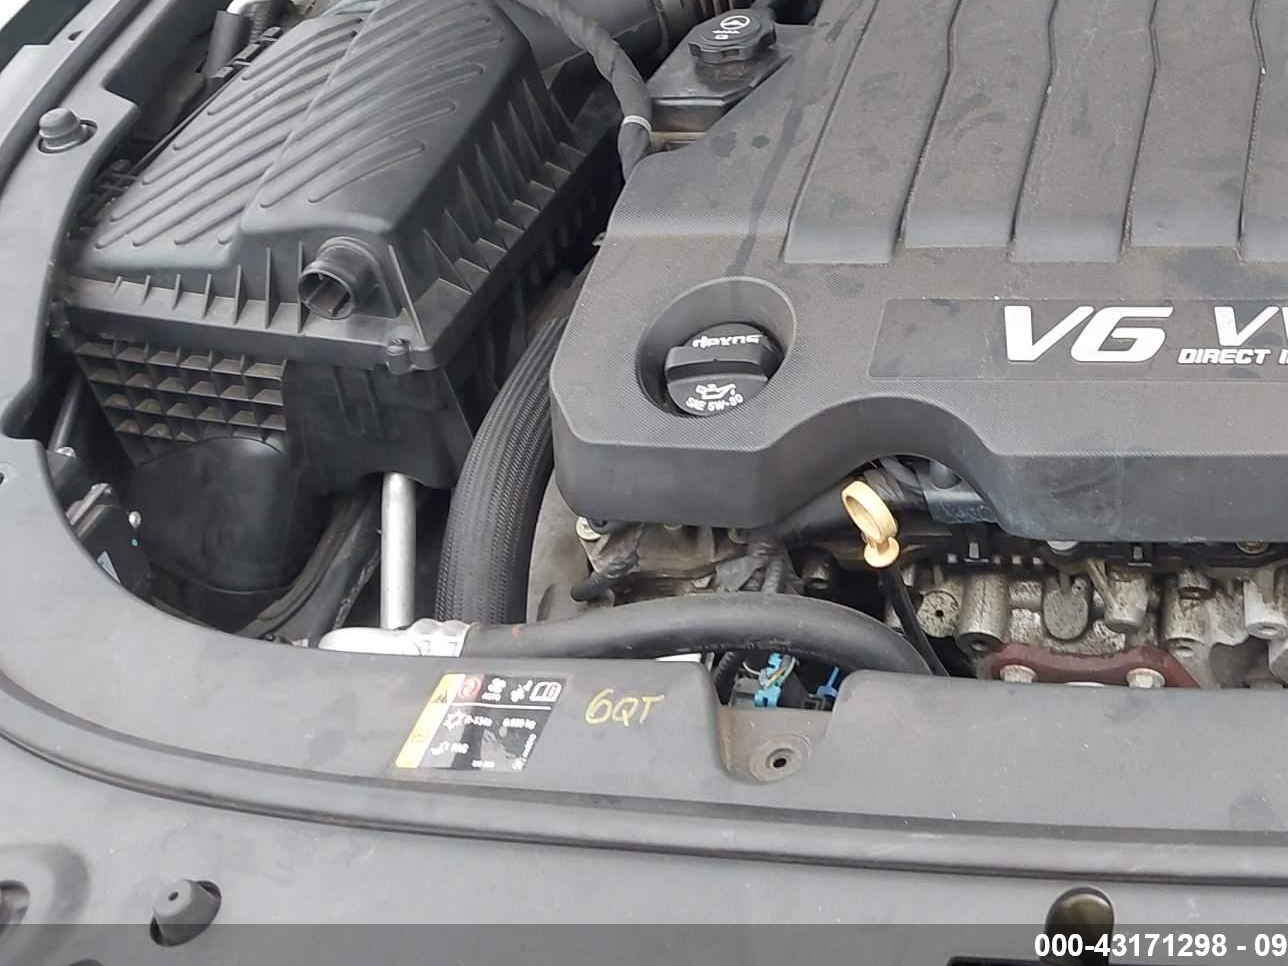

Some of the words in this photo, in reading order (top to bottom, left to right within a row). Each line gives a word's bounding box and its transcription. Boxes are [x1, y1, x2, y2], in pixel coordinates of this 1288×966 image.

[1004, 305, 1174, 362] V6
[1177, 348, 1271, 365] DIRECT
[585, 688, 665, 727] 6QT
